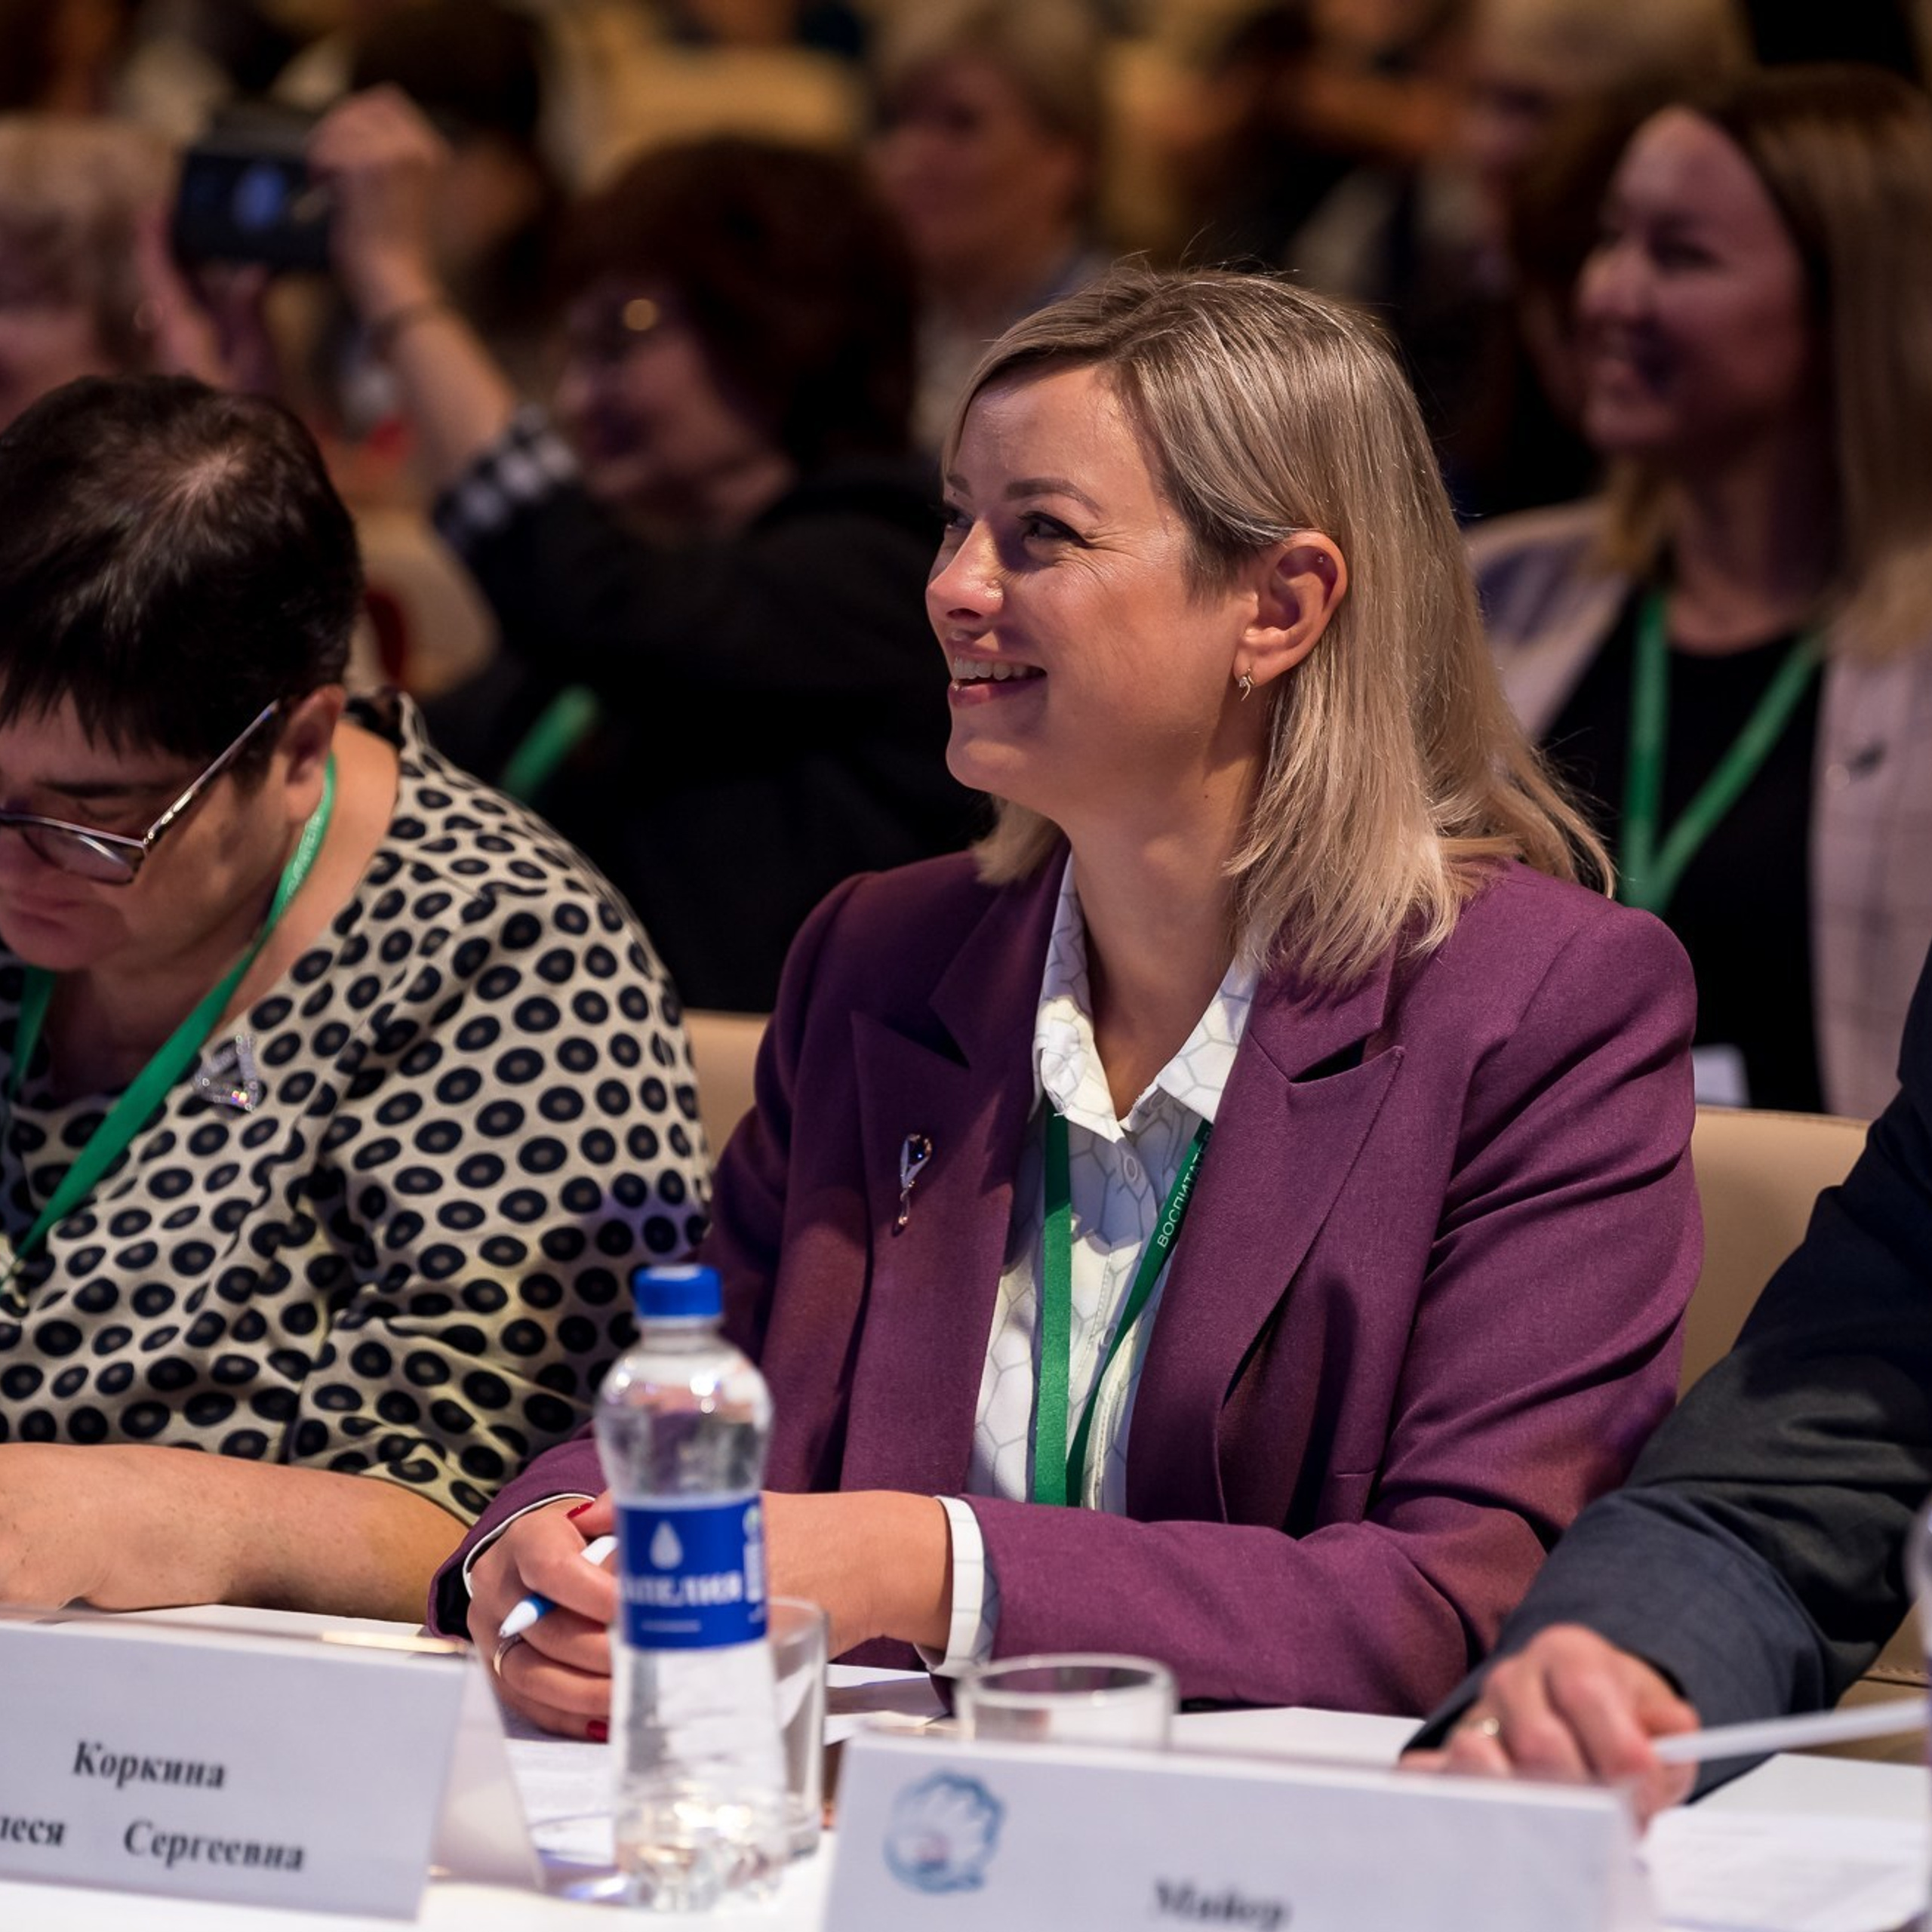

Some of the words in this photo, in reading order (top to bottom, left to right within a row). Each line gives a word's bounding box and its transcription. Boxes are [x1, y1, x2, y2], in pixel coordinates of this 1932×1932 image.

[1157, 1126, 1212, 1247] ВОСПИТАТ
[74, 1740, 226, 1792] Коркина
[123, 1817, 305, 1872] Сергеевна
